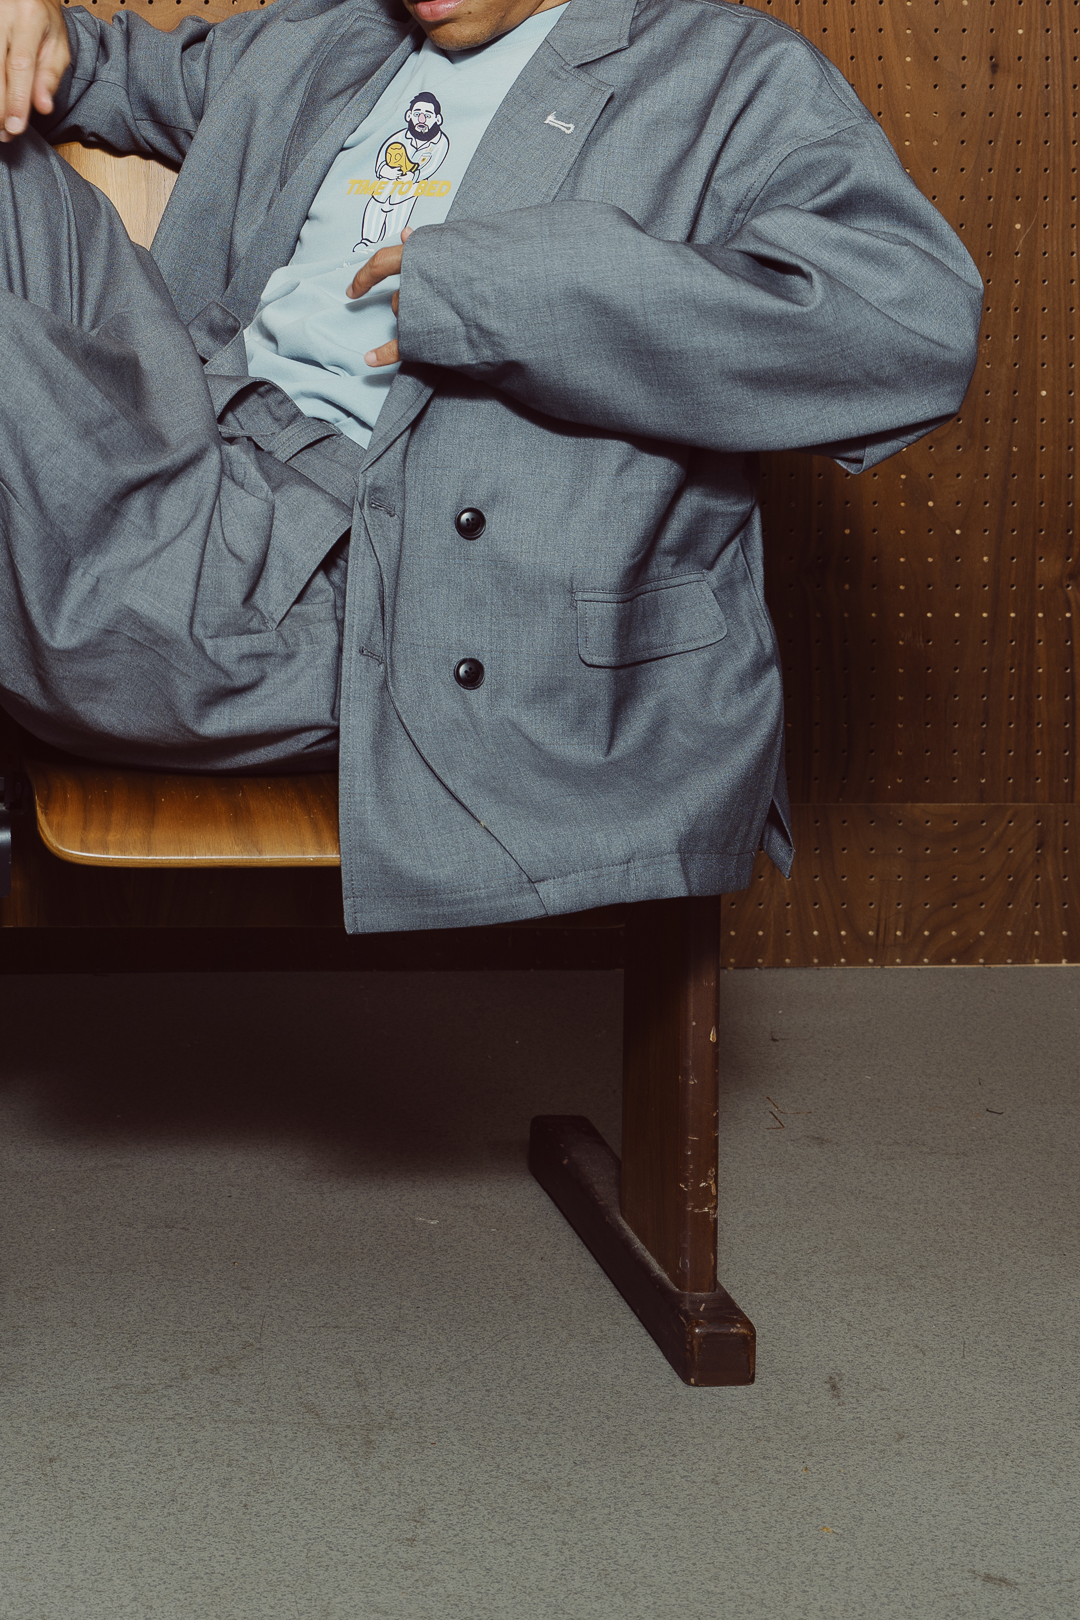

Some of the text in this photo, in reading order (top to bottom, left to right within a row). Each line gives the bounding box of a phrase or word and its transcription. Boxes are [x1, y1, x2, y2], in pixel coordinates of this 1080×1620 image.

[346, 179, 452, 197] TIME TO BED
